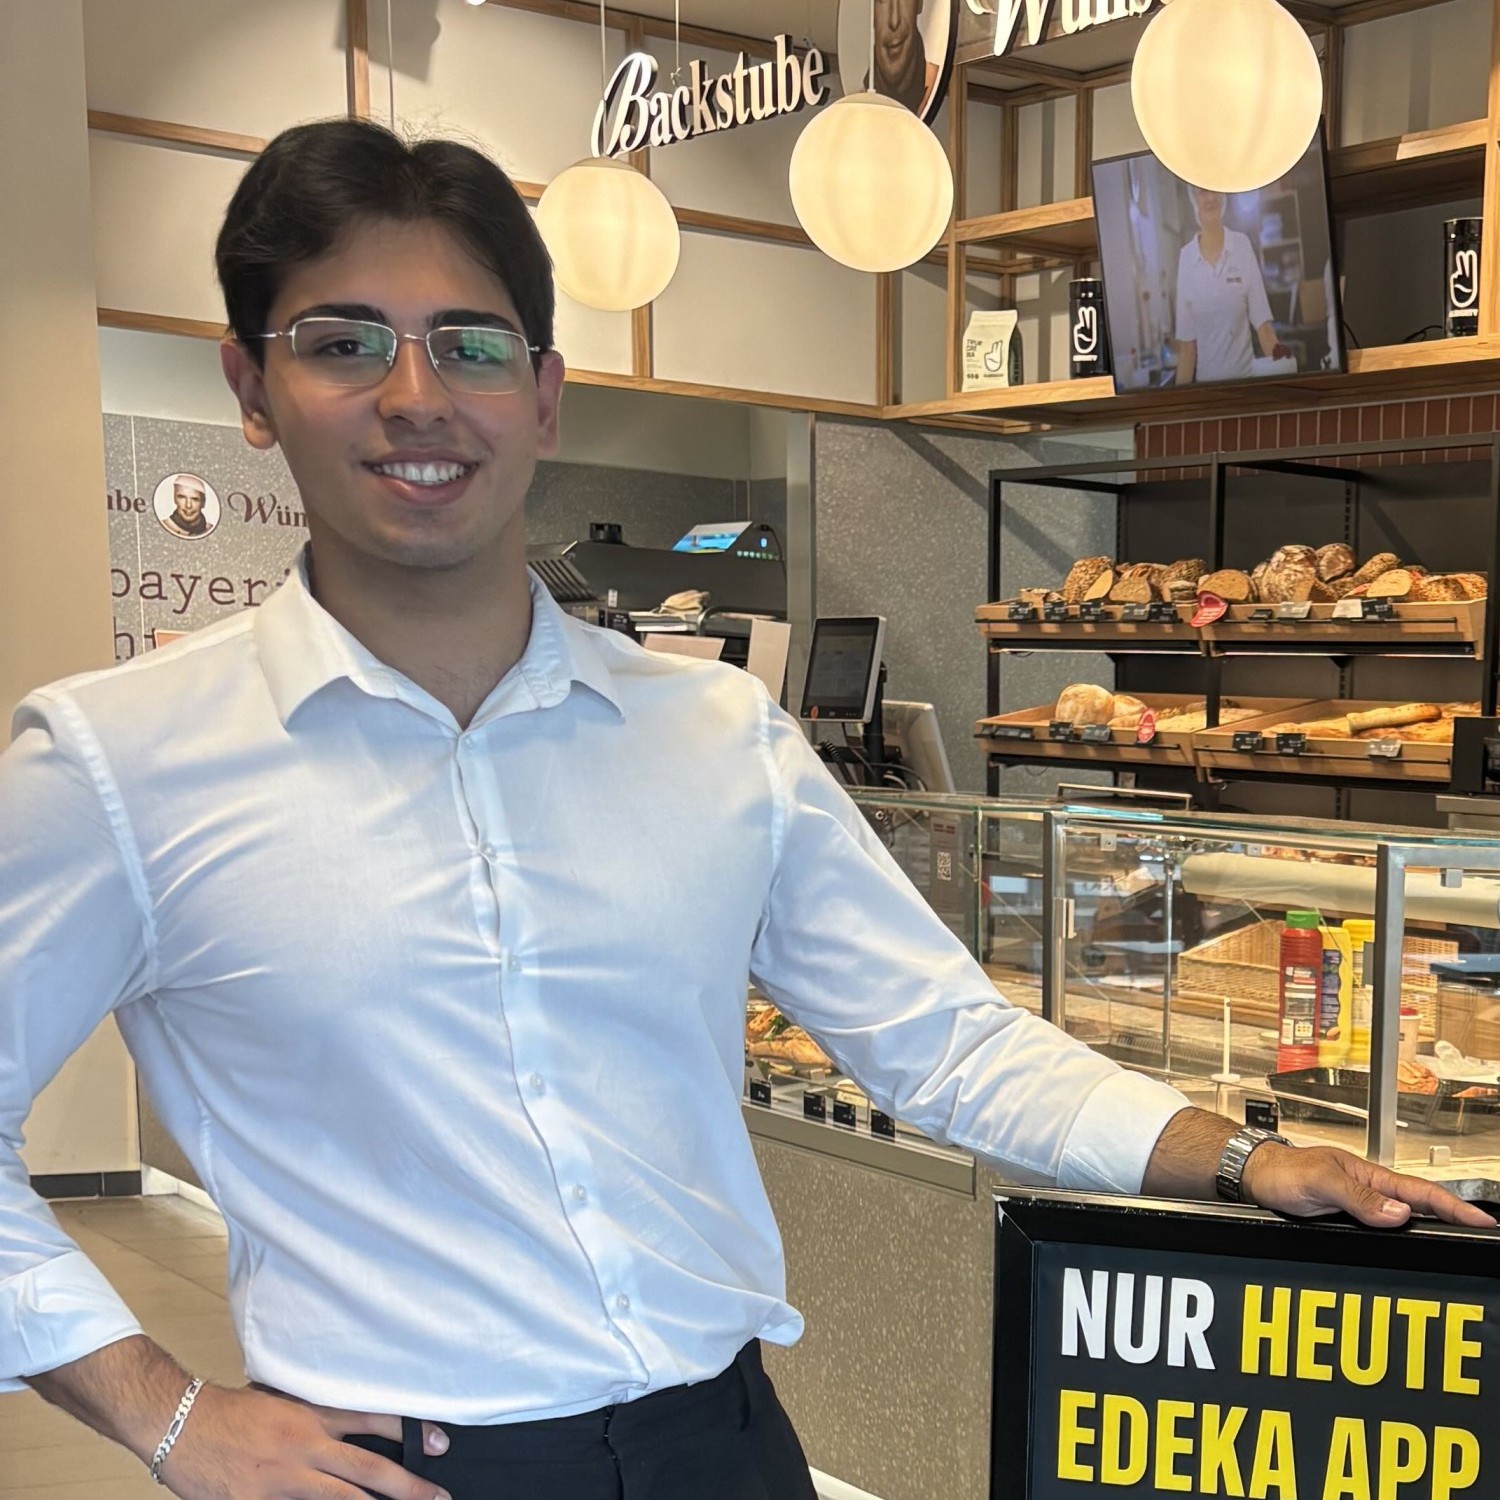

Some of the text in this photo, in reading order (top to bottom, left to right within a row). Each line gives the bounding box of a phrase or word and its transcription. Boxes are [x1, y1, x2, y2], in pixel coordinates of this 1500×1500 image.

[591, 33, 828, 159] Backstube
[1062, 1268, 1215, 1369] NUR
[1241, 1284, 1484, 1395] HEUTE
